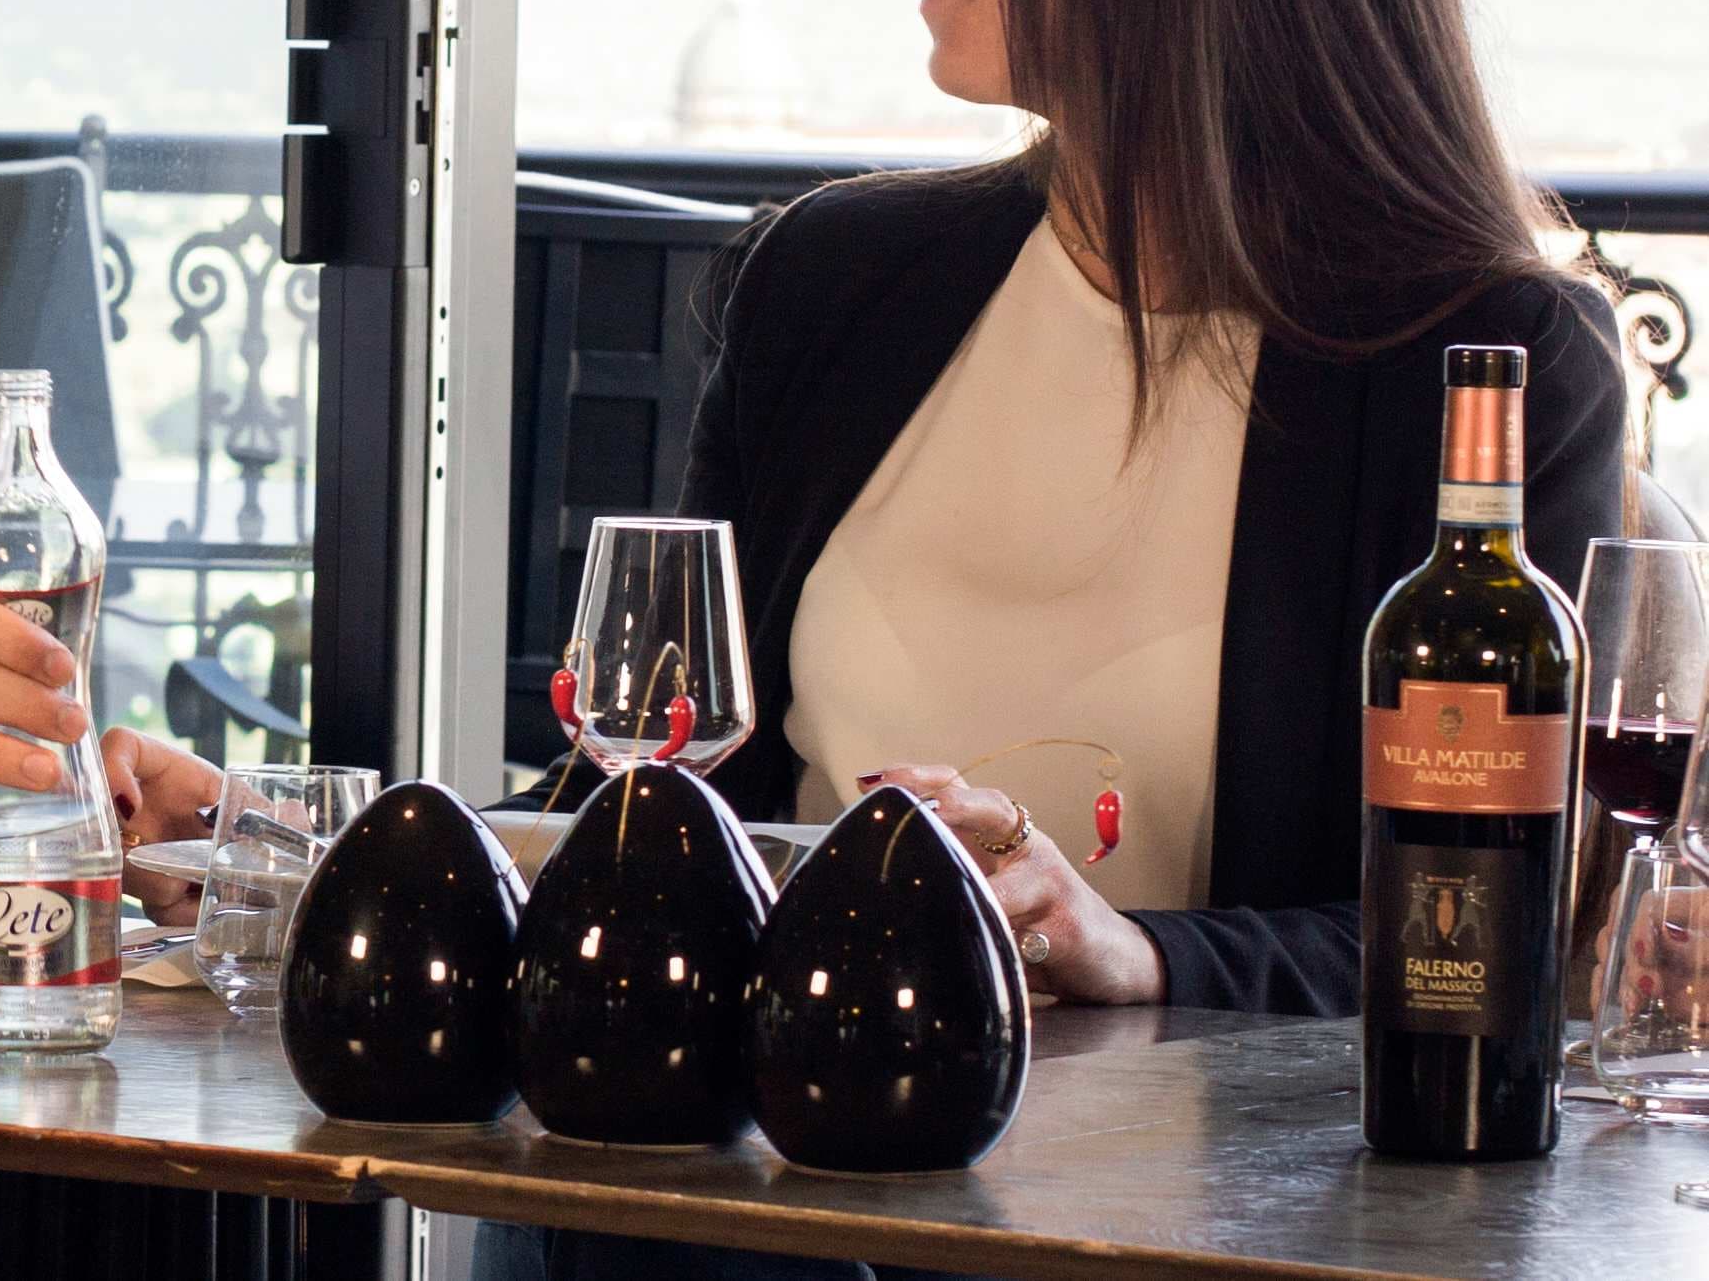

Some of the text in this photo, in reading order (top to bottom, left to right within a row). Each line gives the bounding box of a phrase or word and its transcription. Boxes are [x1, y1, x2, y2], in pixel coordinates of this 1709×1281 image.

[1383, 744, 1527, 770] VILLA MATILDE
[1405, 957, 1486, 979] FALERNO
[1405, 976, 1485, 994] DEL MASSICO
